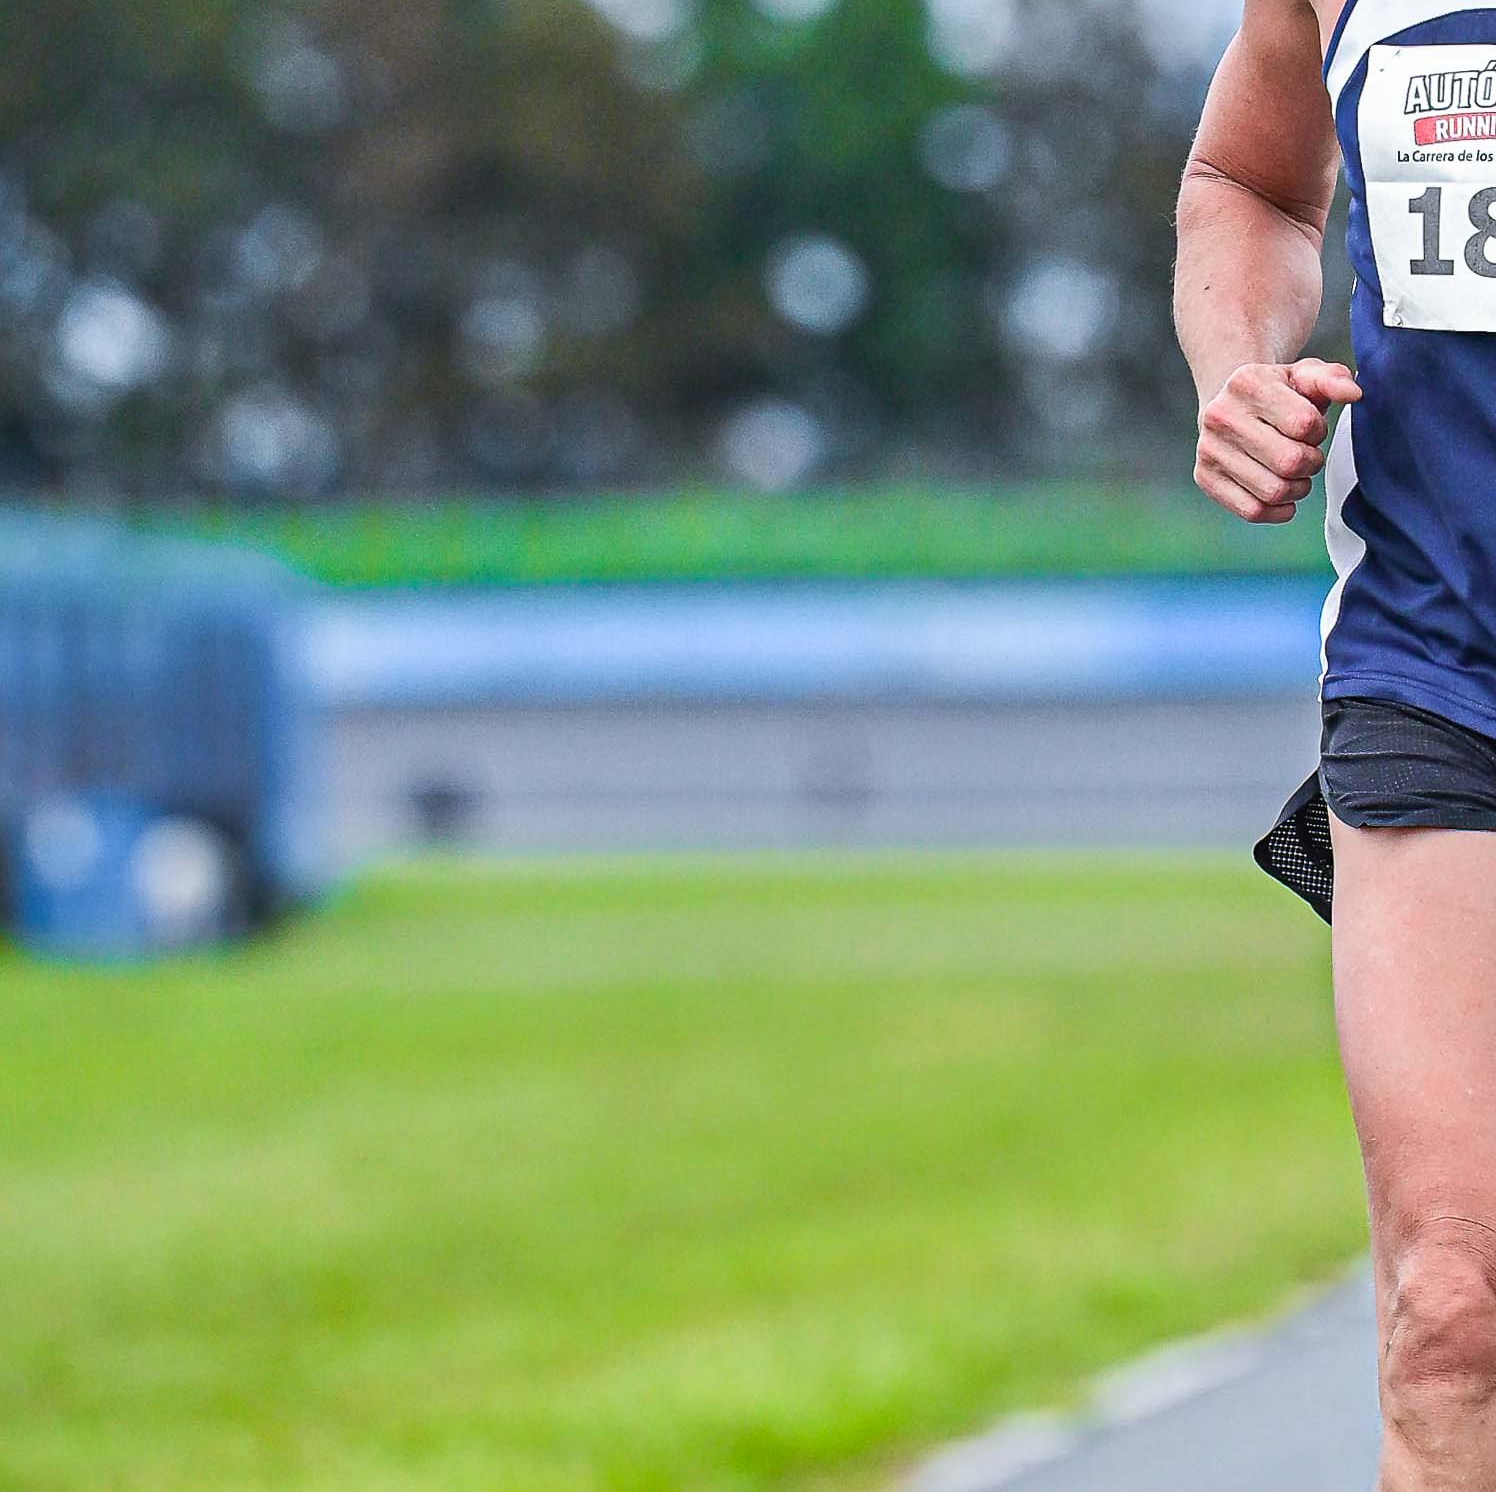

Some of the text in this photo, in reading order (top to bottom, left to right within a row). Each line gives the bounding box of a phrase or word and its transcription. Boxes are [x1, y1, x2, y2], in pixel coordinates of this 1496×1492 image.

[1397, 150, 1410, 162] La
[1412, 150, 1455, 162] Carrera
[1458, 150, 1473, 162] de
[1476, 149, 1494, 162] los
